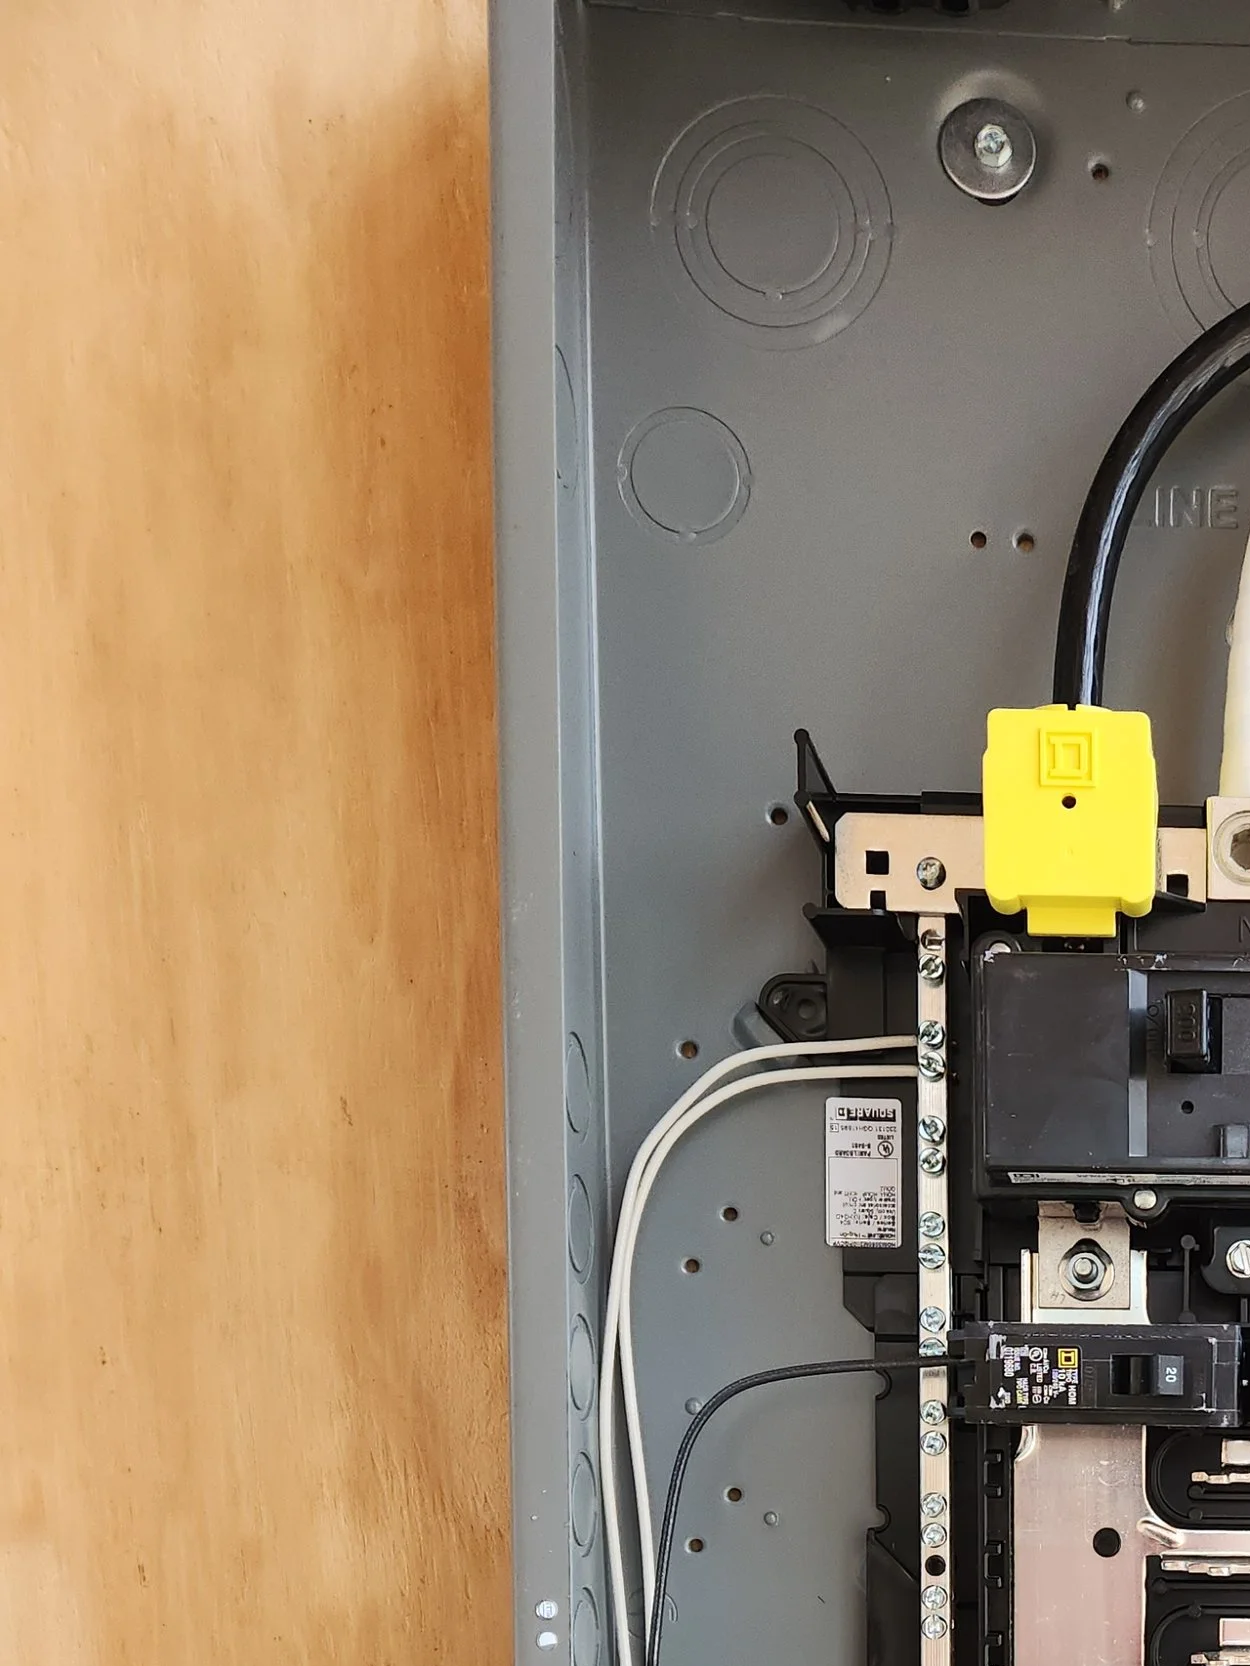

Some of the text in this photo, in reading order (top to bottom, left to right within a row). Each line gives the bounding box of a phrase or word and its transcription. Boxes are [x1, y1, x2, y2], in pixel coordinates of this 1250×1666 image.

[1148, 485, 1239, 530] INE
[849, 1108, 894, 1119] SQUARE
[1058, 1369, 1066, 1393] 10 kA
[1165, 1366, 1178, 1383] 20
[1068, 1385, 1077, 1405] HOM
